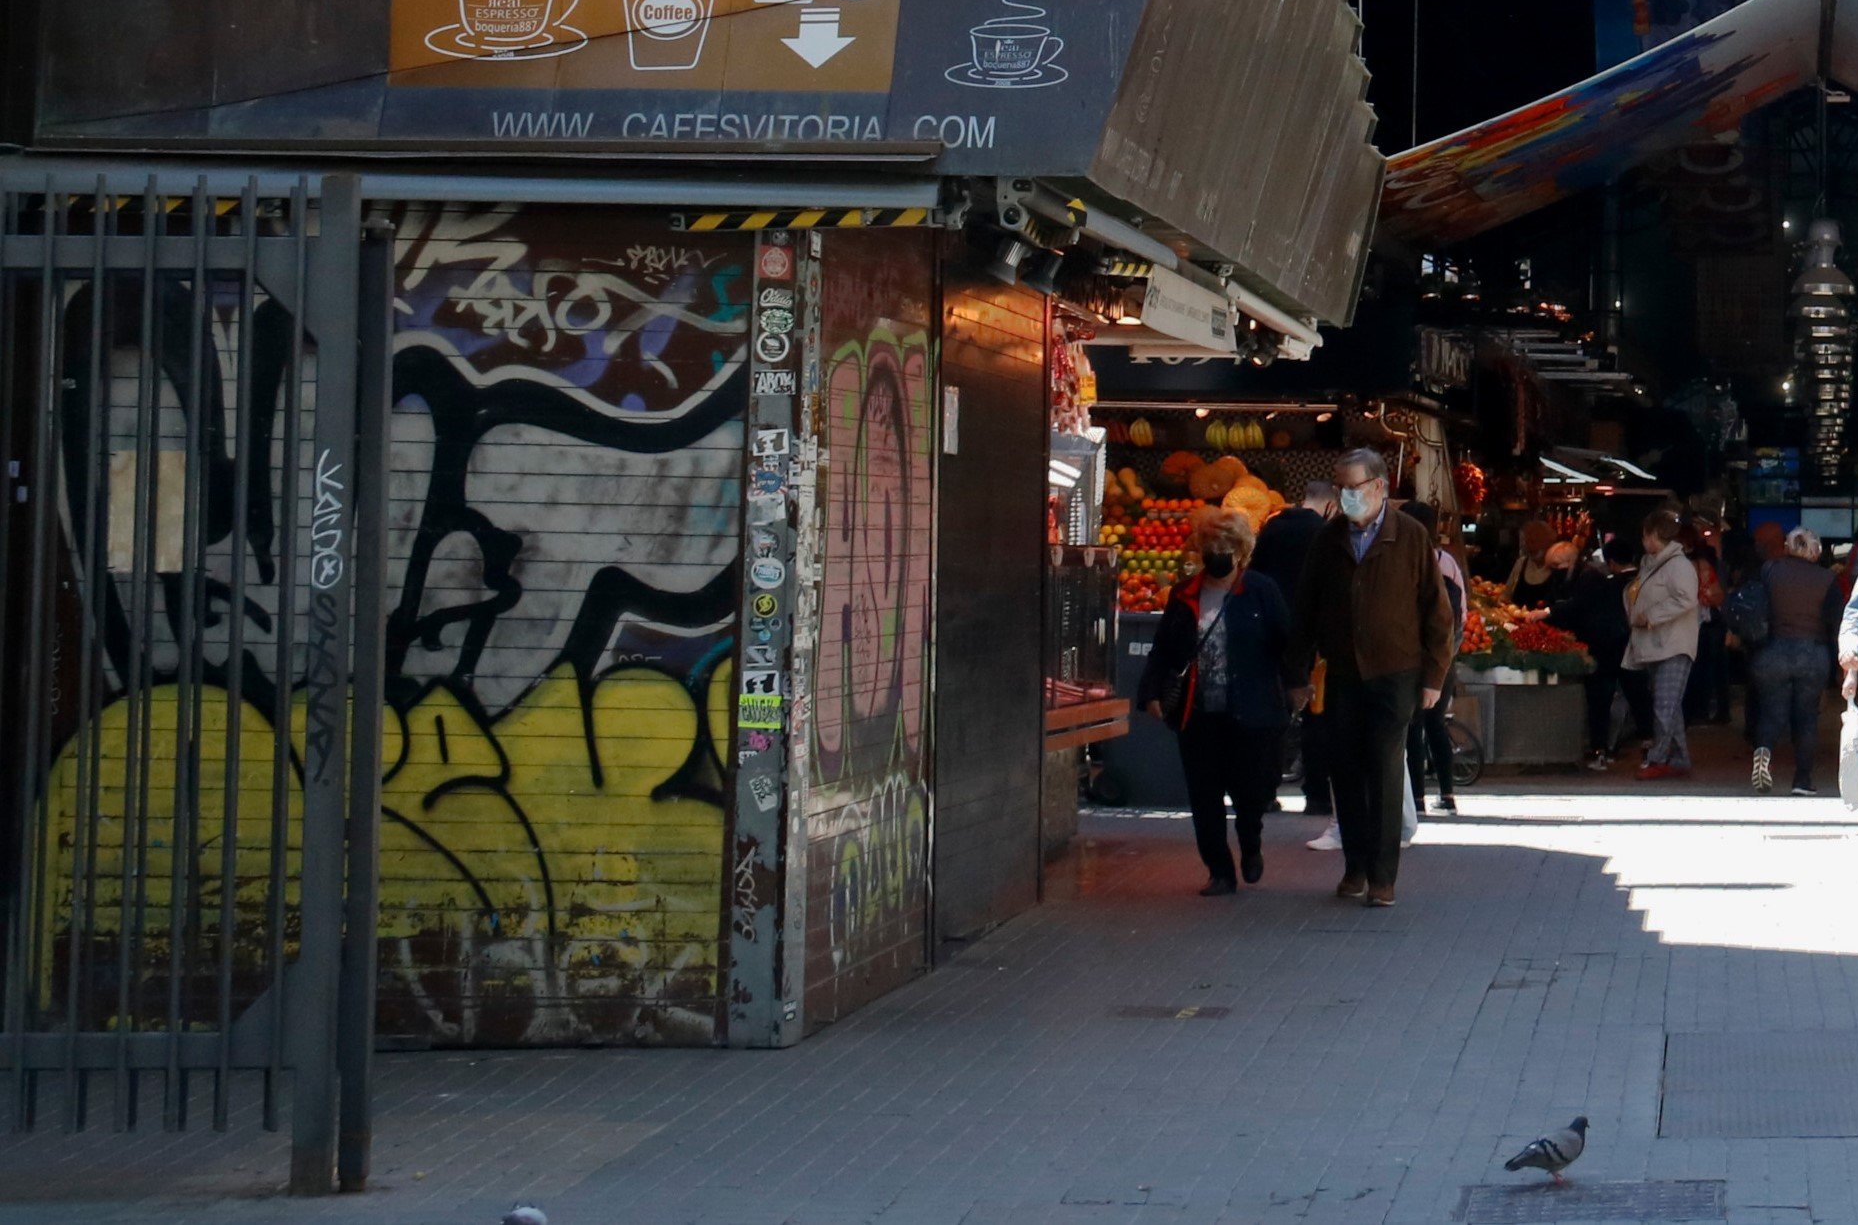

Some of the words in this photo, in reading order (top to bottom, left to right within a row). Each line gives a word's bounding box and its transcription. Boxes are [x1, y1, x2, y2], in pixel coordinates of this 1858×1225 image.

[475, 7, 539, 19] ESPRESSO
[643, 3, 694, 21] Coffee
[474, 20, 538, 34] boqueria887
